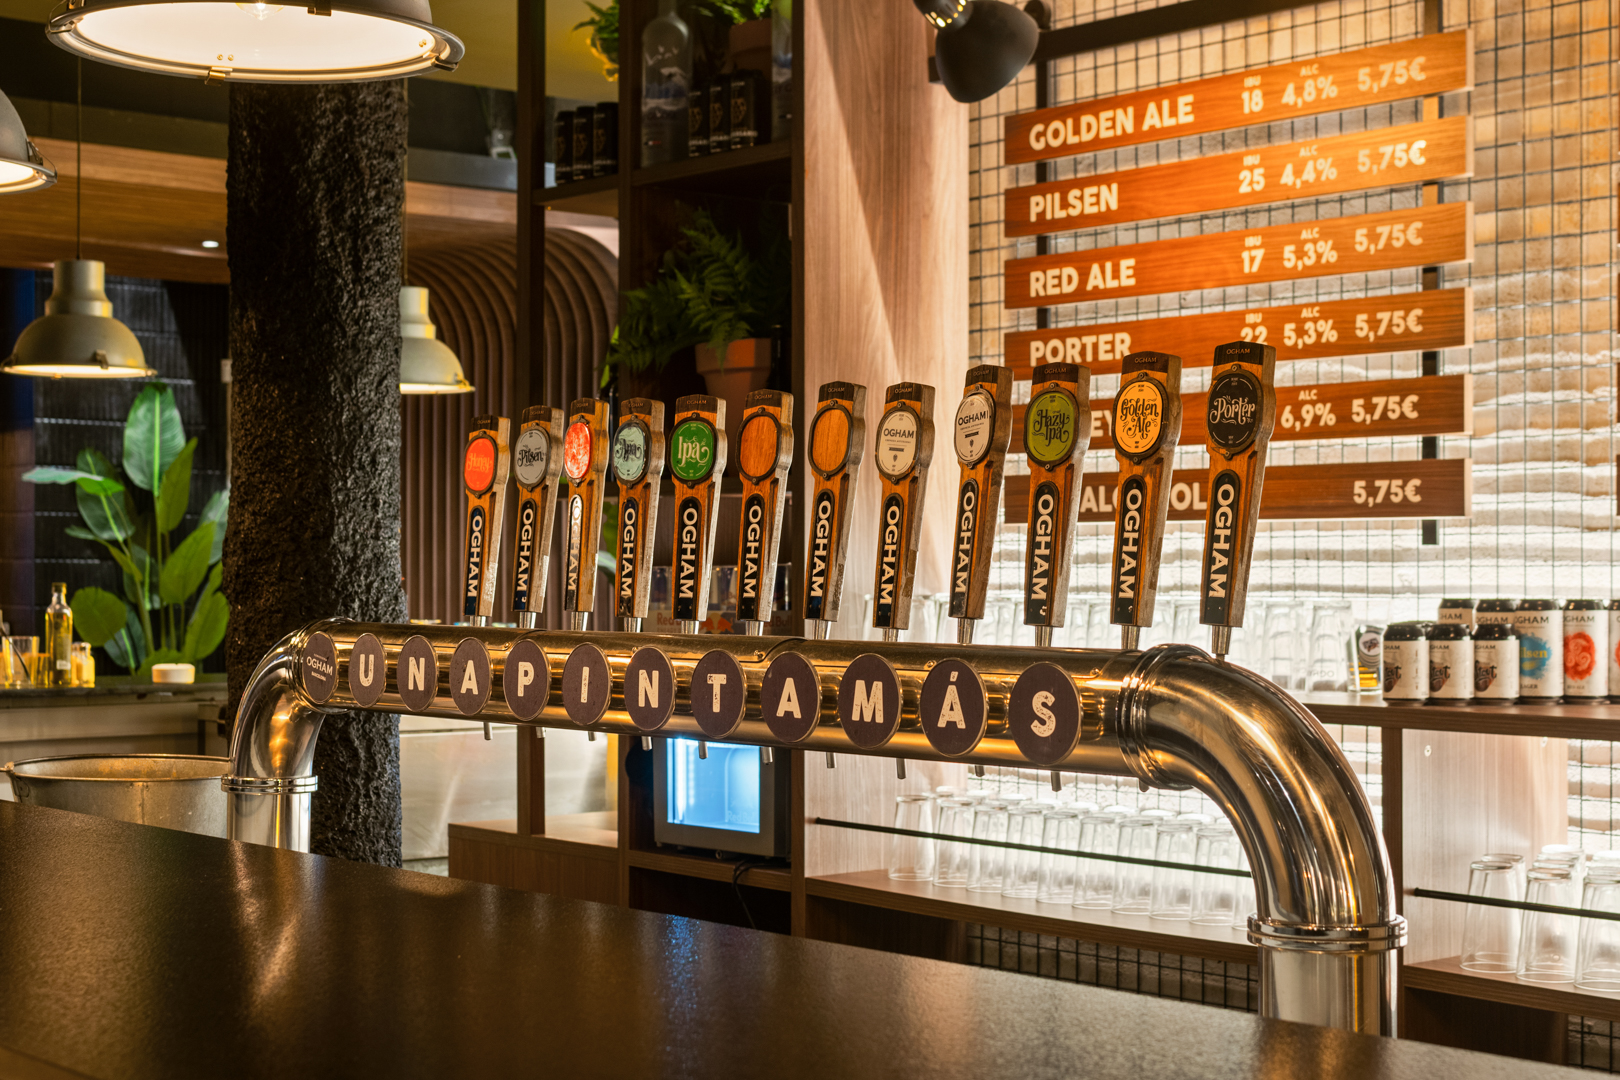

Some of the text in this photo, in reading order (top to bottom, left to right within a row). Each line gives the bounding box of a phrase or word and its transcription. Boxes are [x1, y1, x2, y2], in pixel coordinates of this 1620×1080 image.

[1241, 56, 1426, 115] 18 4,8% 5,75€
[1244, 75, 1261, 88] IBU
[1300, 63, 1319, 77] ALC
[1029, 94, 1195, 151] GOLDEN ALE
[1243, 154, 1260, 167] IBU
[1299, 145, 1318, 157] ALC
[1029, 139, 1427, 223] PILSEN 25 4,4% 5,75€
[1245, 235, 1262, 247] IBU
[1301, 227, 1320, 239] ALC
[1029, 221, 1423, 298] RED ALE 17 5,3% 5,75€
[1245, 312, 1262, 324] IBU
[1301, 306, 1320, 318] ALC
[1029, 308, 1423, 367] PORTER 22 5,3% 5,75€
[1120, 398, 1159, 422] Golden
[1209, 396, 1256, 425] Porter
[1280, 394, 1419, 430] 6,9% 5,75€
[1298, 389, 1318, 400] ALC
[883, 428, 915, 439] OGHAM
[957, 410, 987, 426] OGHAM
[1033, 409, 1070, 433] Hazy
[1126, 417, 1152, 440] Ale
[1080, 478, 1421, 513] ALOL 5,75€
[467, 515, 483, 597] OGHAM
[516, 508, 534, 591] OGHAM
[567, 505, 581, 591] OGHAM
[620, 507, 636, 597] OGHAM
[679, 507, 698, 599] OGHAM
[742, 505, 762, 599] OGHAM
[810, 500, 832, 598] OGHAM
[879, 505, 900, 605] OGHAM
[954, 490, 975, 593] OGHAM
[1031, 494, 1054, 600] OGHAM
[1118, 488, 1142, 600] OGHAM
[1208, 483, 1235, 599] OGHAM
[306, 656, 333, 676] OGHAM
[358, 653, 375, 687] U
[1520, 646, 1548, 659] ilsen
[408, 656, 425, 690] N
[460, 659, 479, 695] A
[517, 661, 535, 697] P
[580, 666, 590, 703] I
[637, 669, 659, 709] N
[706, 673, 727, 713] T
[776, 677, 802, 719] A
[851, 679, 884, 724] M
[1030, 690, 1056, 738] S
